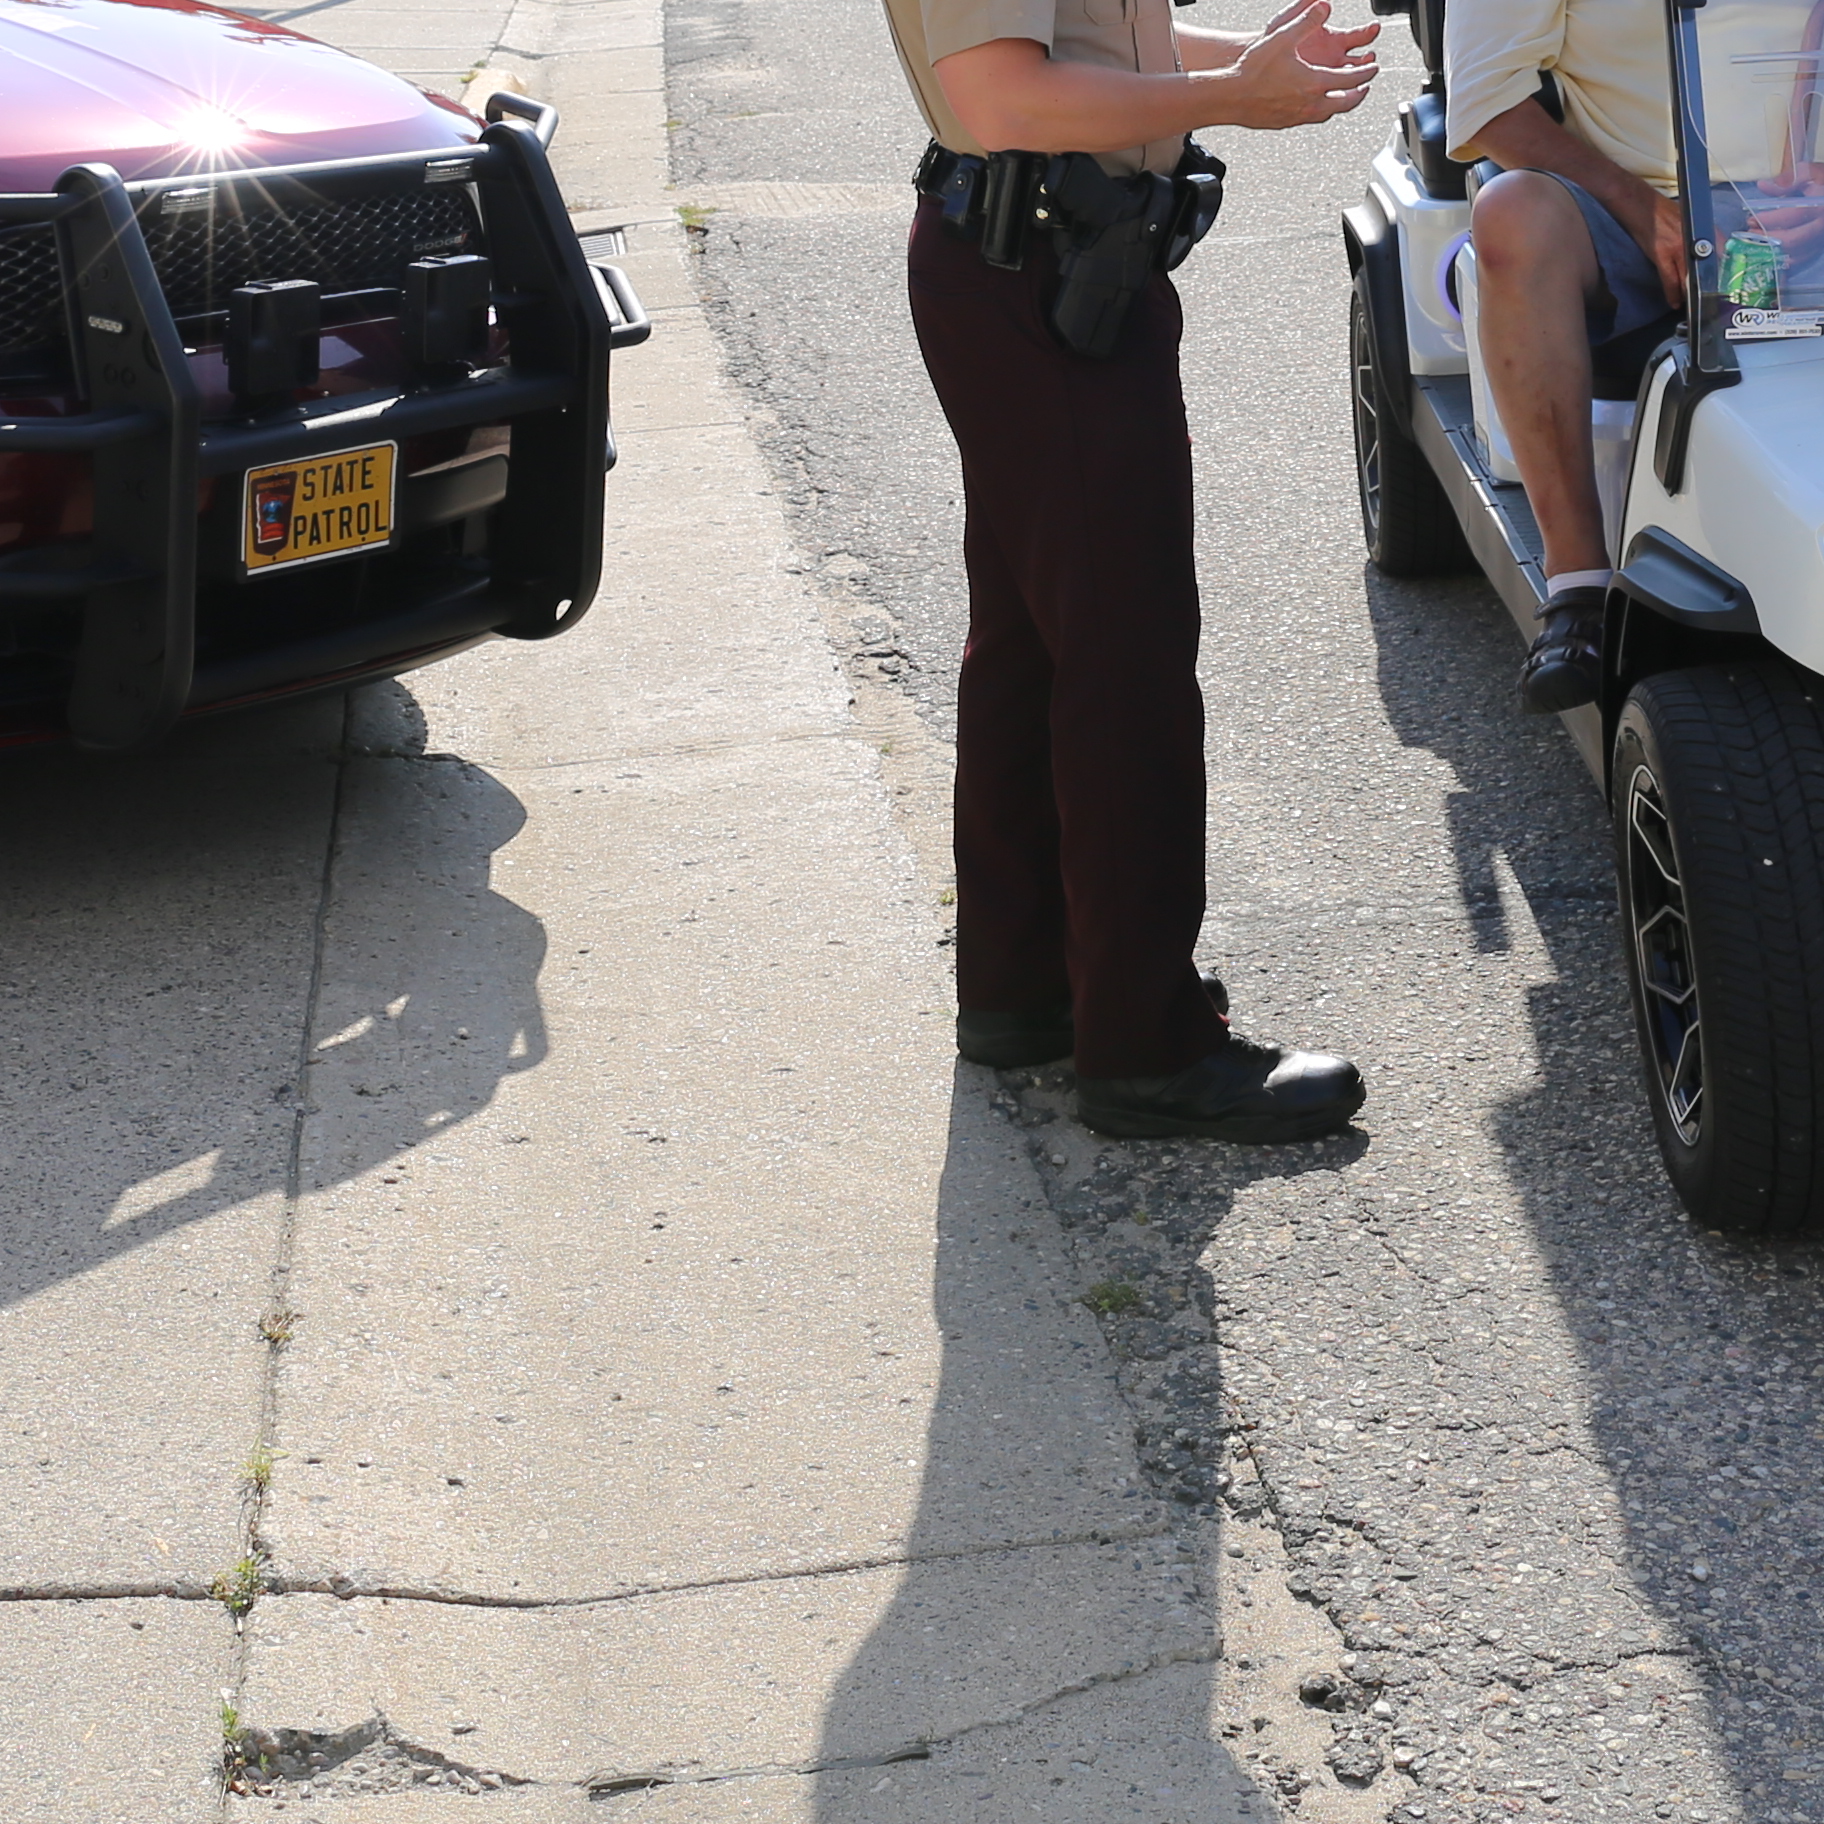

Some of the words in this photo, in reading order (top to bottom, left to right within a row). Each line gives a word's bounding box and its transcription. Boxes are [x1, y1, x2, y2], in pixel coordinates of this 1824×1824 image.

[413, 235, 462, 251] DODGE
[302, 456, 375, 502] STATE
[293, 500, 387, 550] PATROL
